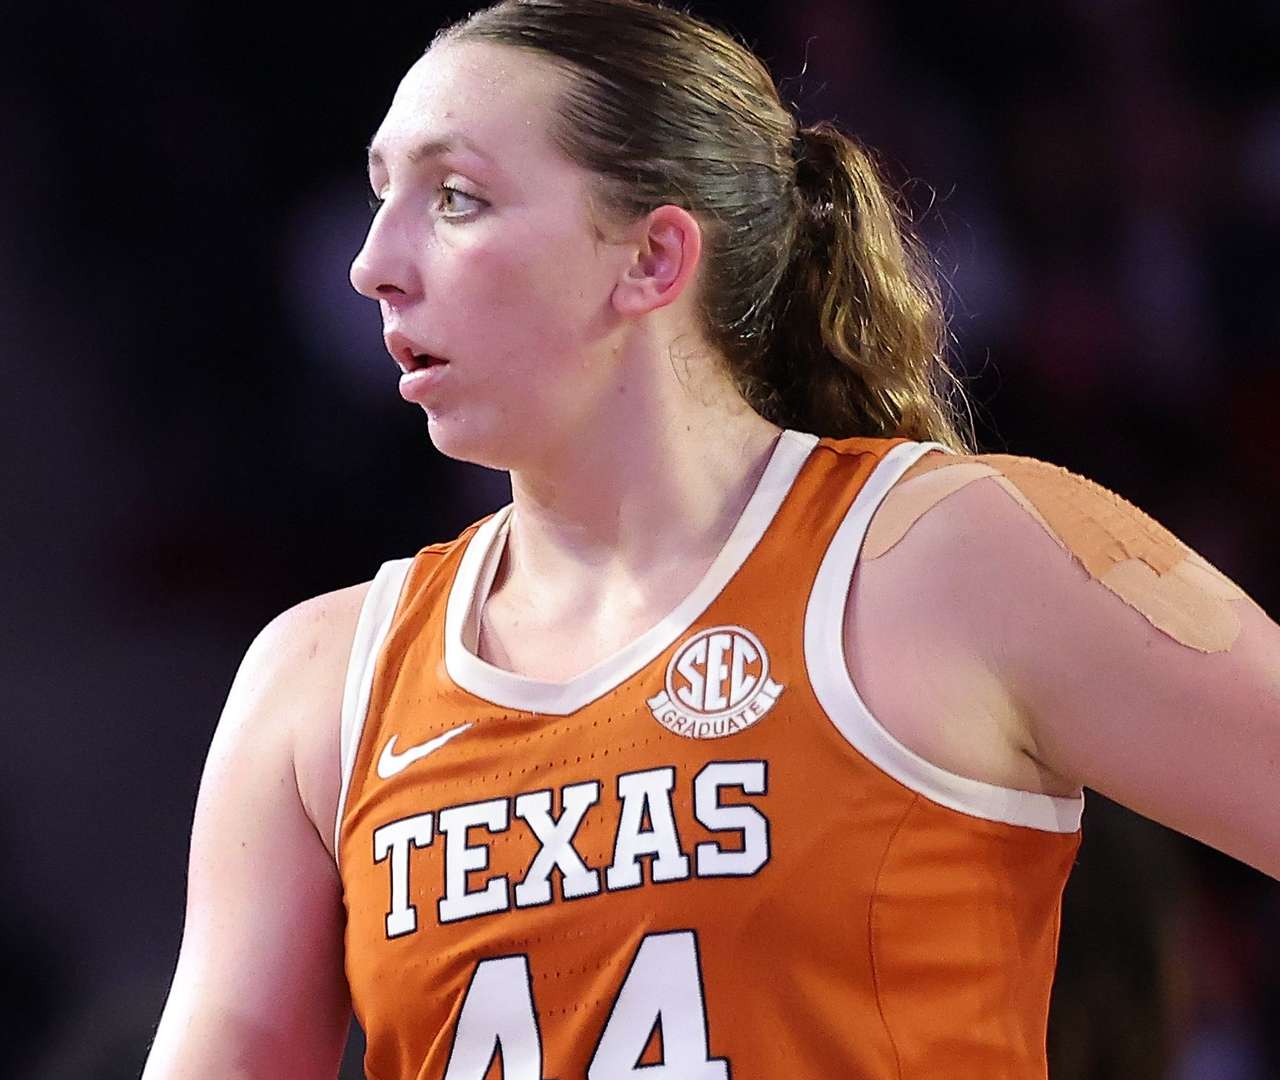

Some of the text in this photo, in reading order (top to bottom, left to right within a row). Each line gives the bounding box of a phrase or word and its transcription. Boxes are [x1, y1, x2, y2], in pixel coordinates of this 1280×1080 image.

[676, 633, 759, 711] SEC
[661, 701, 765, 738] GRADUATE
[374, 760, 771, 939] TEXAS
